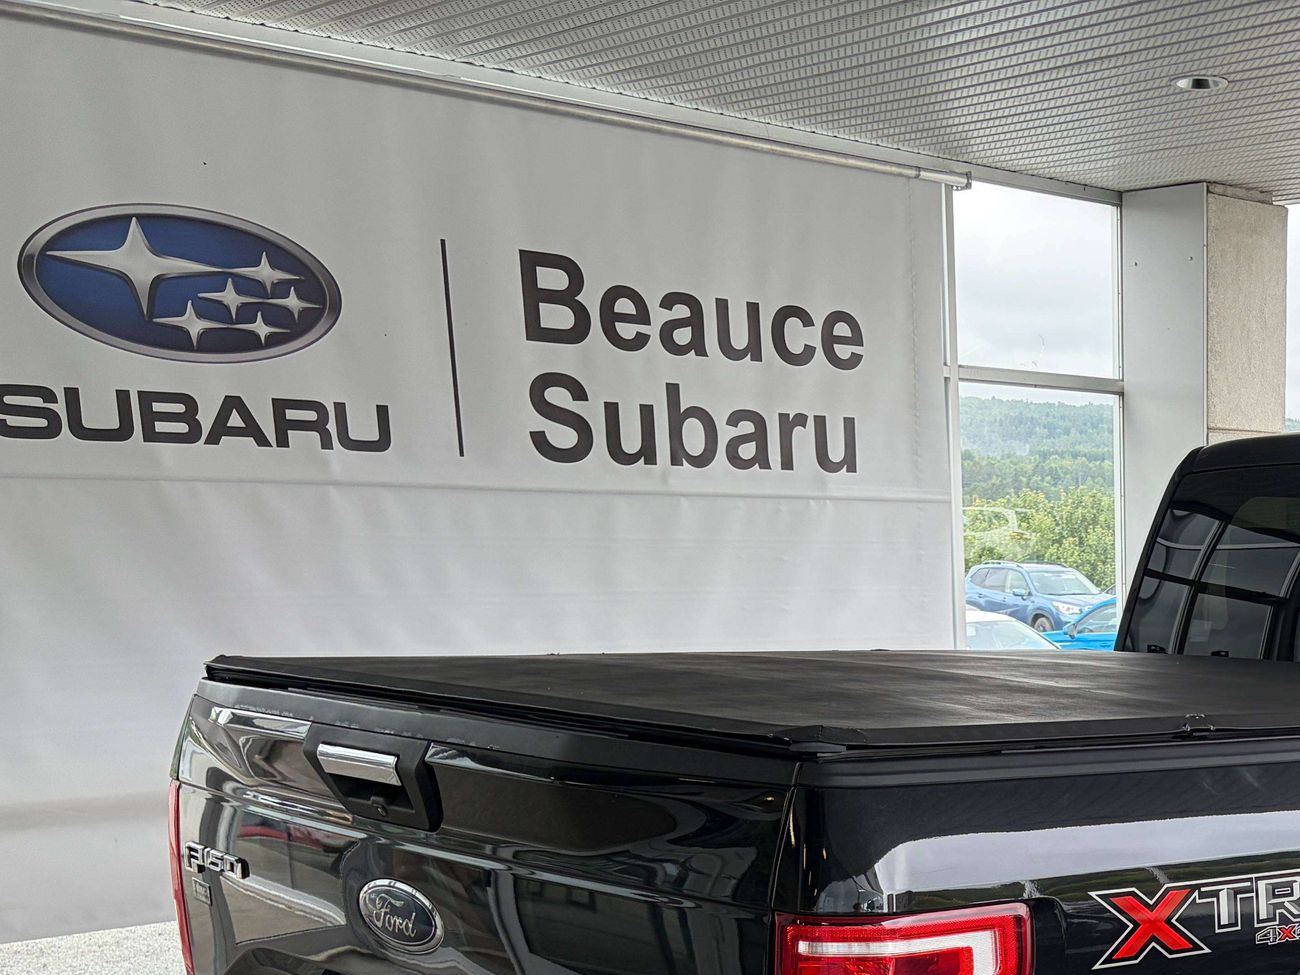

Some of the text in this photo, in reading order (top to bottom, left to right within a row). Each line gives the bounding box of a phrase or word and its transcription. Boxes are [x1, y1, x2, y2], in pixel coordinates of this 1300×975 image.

[519, 249, 864, 371] Beauce
[0, 384, 392, 453] SUBARU
[530, 372, 857, 474] Subaru
[366, 893, 417, 938] Ford
